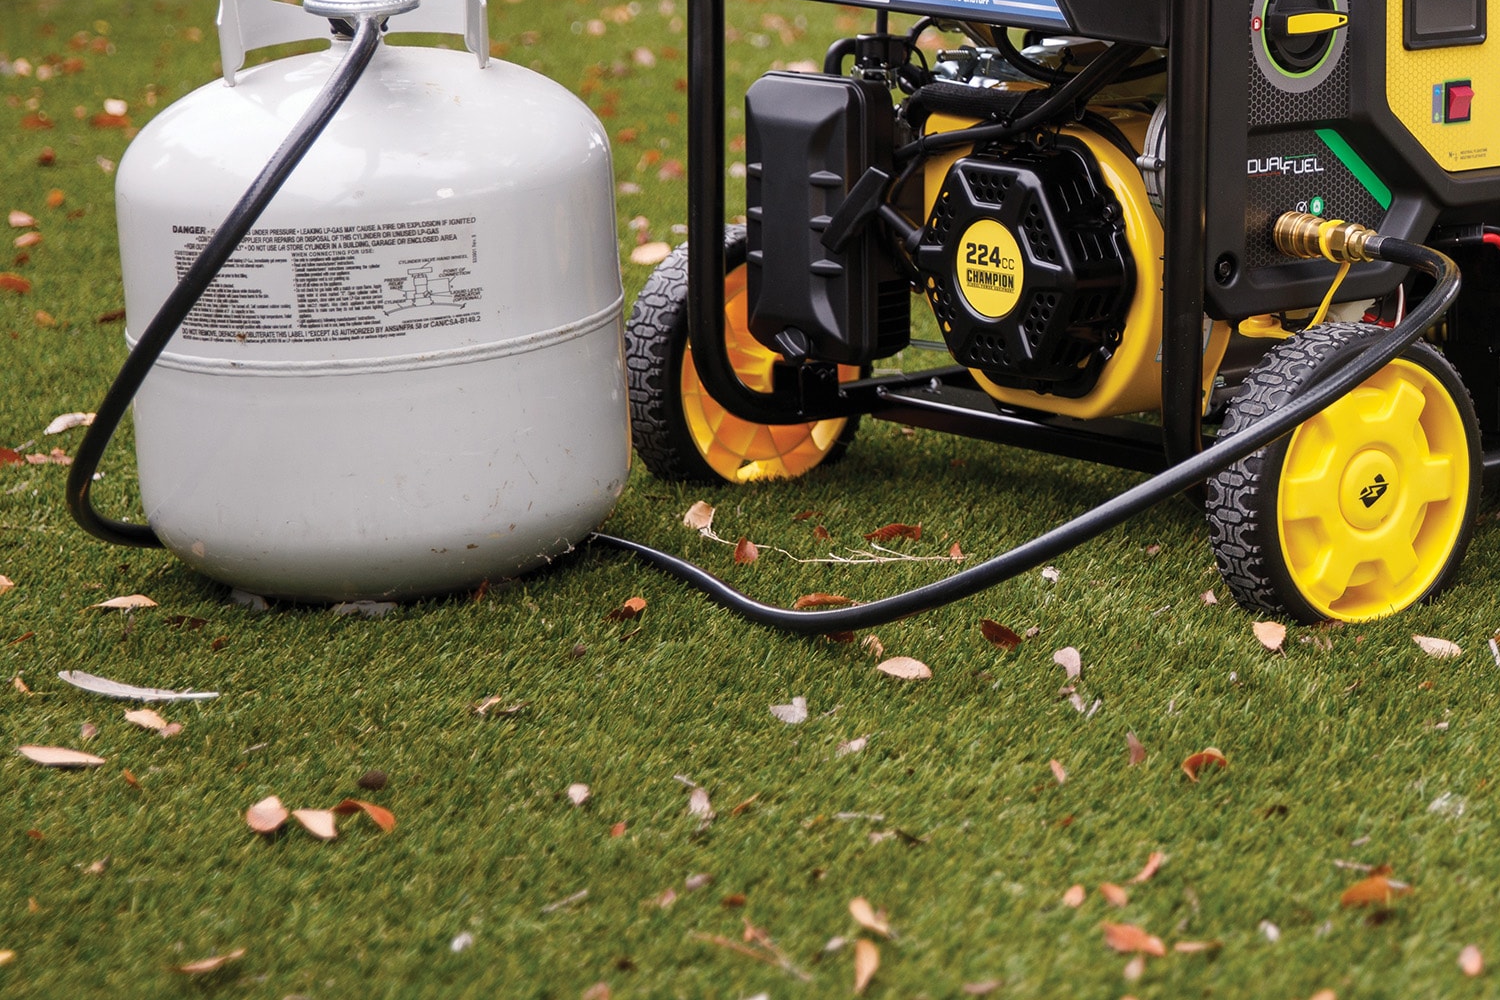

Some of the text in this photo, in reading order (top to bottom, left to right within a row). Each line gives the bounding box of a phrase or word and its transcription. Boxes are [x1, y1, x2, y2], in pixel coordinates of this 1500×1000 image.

[1247, 156, 1324, 175] DUAL FUEL
[172, 225, 206, 234] DANGER
[300, 227, 322, 235] LEAKING
[324, 226, 343, 234] LP-GAS
[356, 224, 375, 232] CAUSE
[407, 220, 441, 229] EXPLOSION
[449, 216, 477, 226] IGNITED
[286, 243, 304, 251] STORE
[343, 240, 370, 249] BUILDING,
[371, 239, 396, 247] GARAGE
[407, 236, 440, 244] ENCLOSED
[440, 233, 458, 242] AREA
[304, 235, 330, 243] DISPOSAL
[339, 233, 352, 241] THIS
[352, 232, 381, 240] CYLINDER
[392, 229, 416, 237] UNUSED
[417, 228, 440, 236] LP-GAS
[309, 249, 346, 257] CONNECTING
[967, 269, 1015, 289] CHAMPION
[288, 330, 304, 338] LABEL
[340, 327, 375, 336] AUTHORIZED
[375, 326, 383, 334] BY
